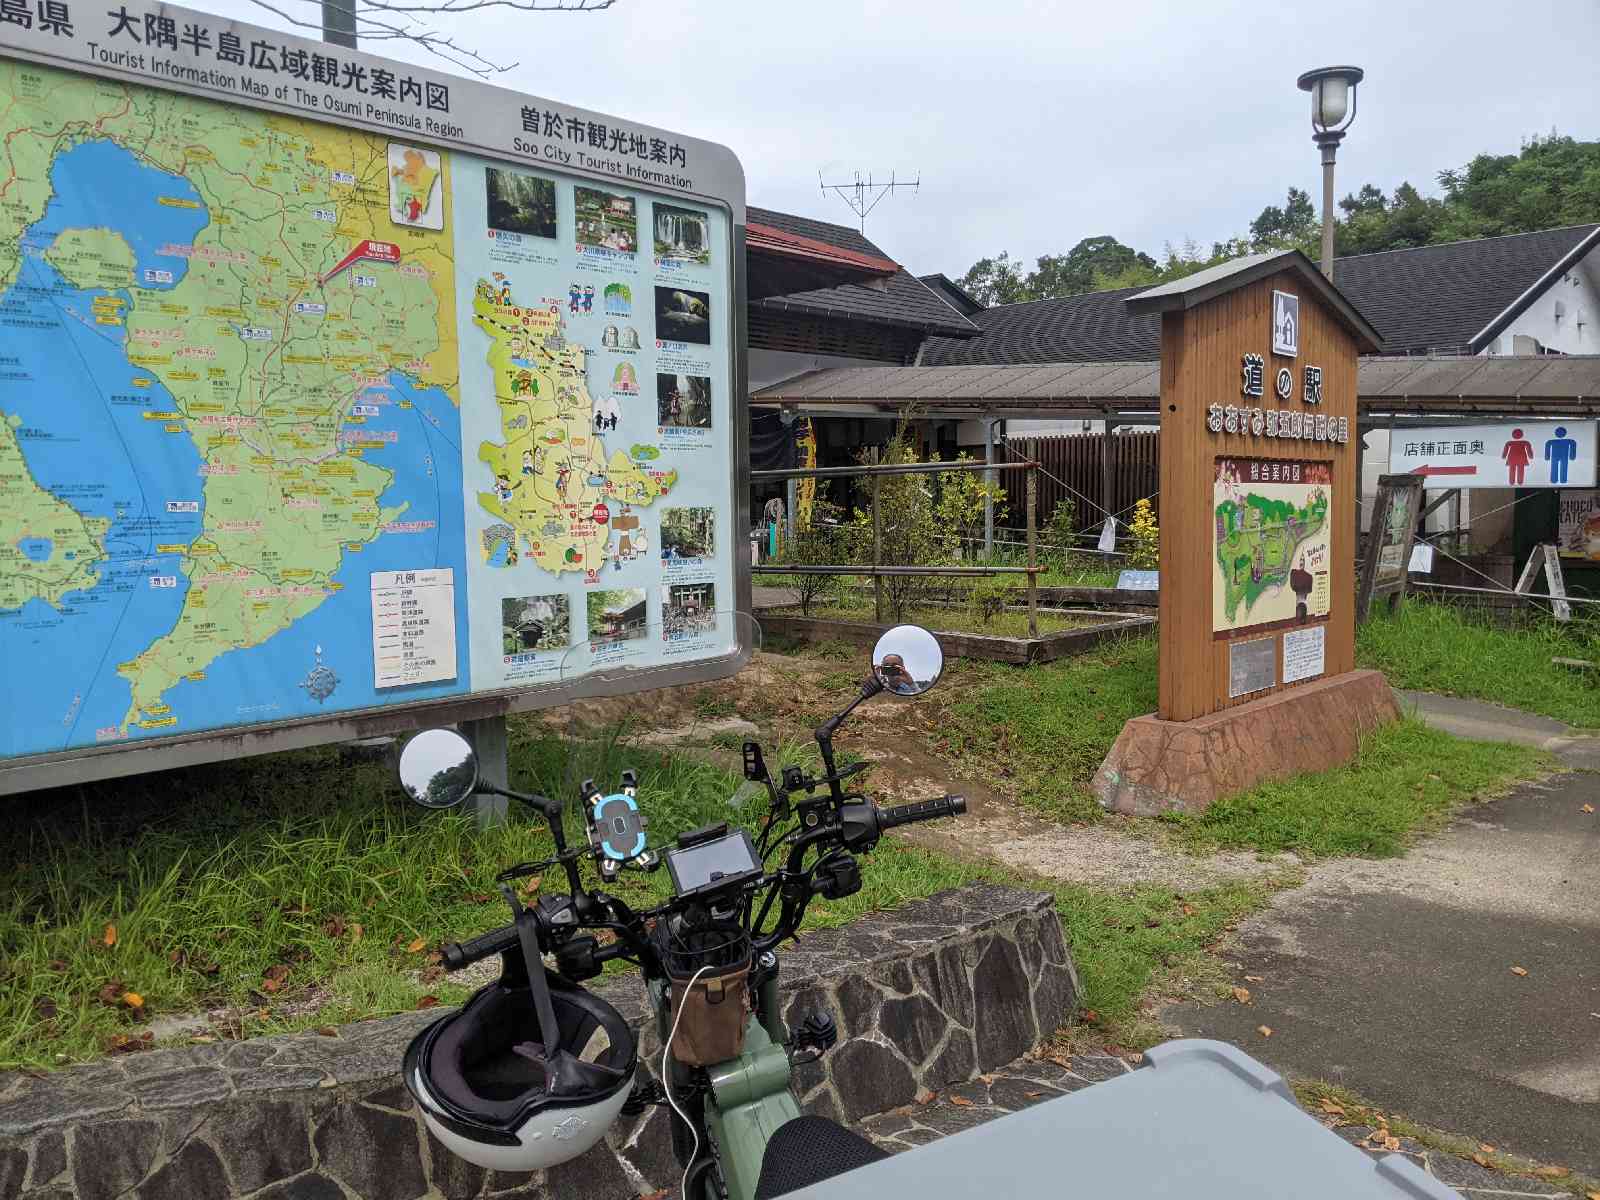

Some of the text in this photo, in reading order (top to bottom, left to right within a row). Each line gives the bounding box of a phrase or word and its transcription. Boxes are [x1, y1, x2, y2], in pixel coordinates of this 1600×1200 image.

[106, 6, 449, 113] 大隅半島広域観光案内図
[87, 41, 464, 138] Tourist Information Map of The Osumi Peninsula Region
[513, 137, 693, 190] Soo City Tourist Information
[520, 105, 687, 168] 曽於市観光地案内
[1242, 352, 1323, 406] 道の駅
[1403, 440, 1485, 457] 店舗正面奥
